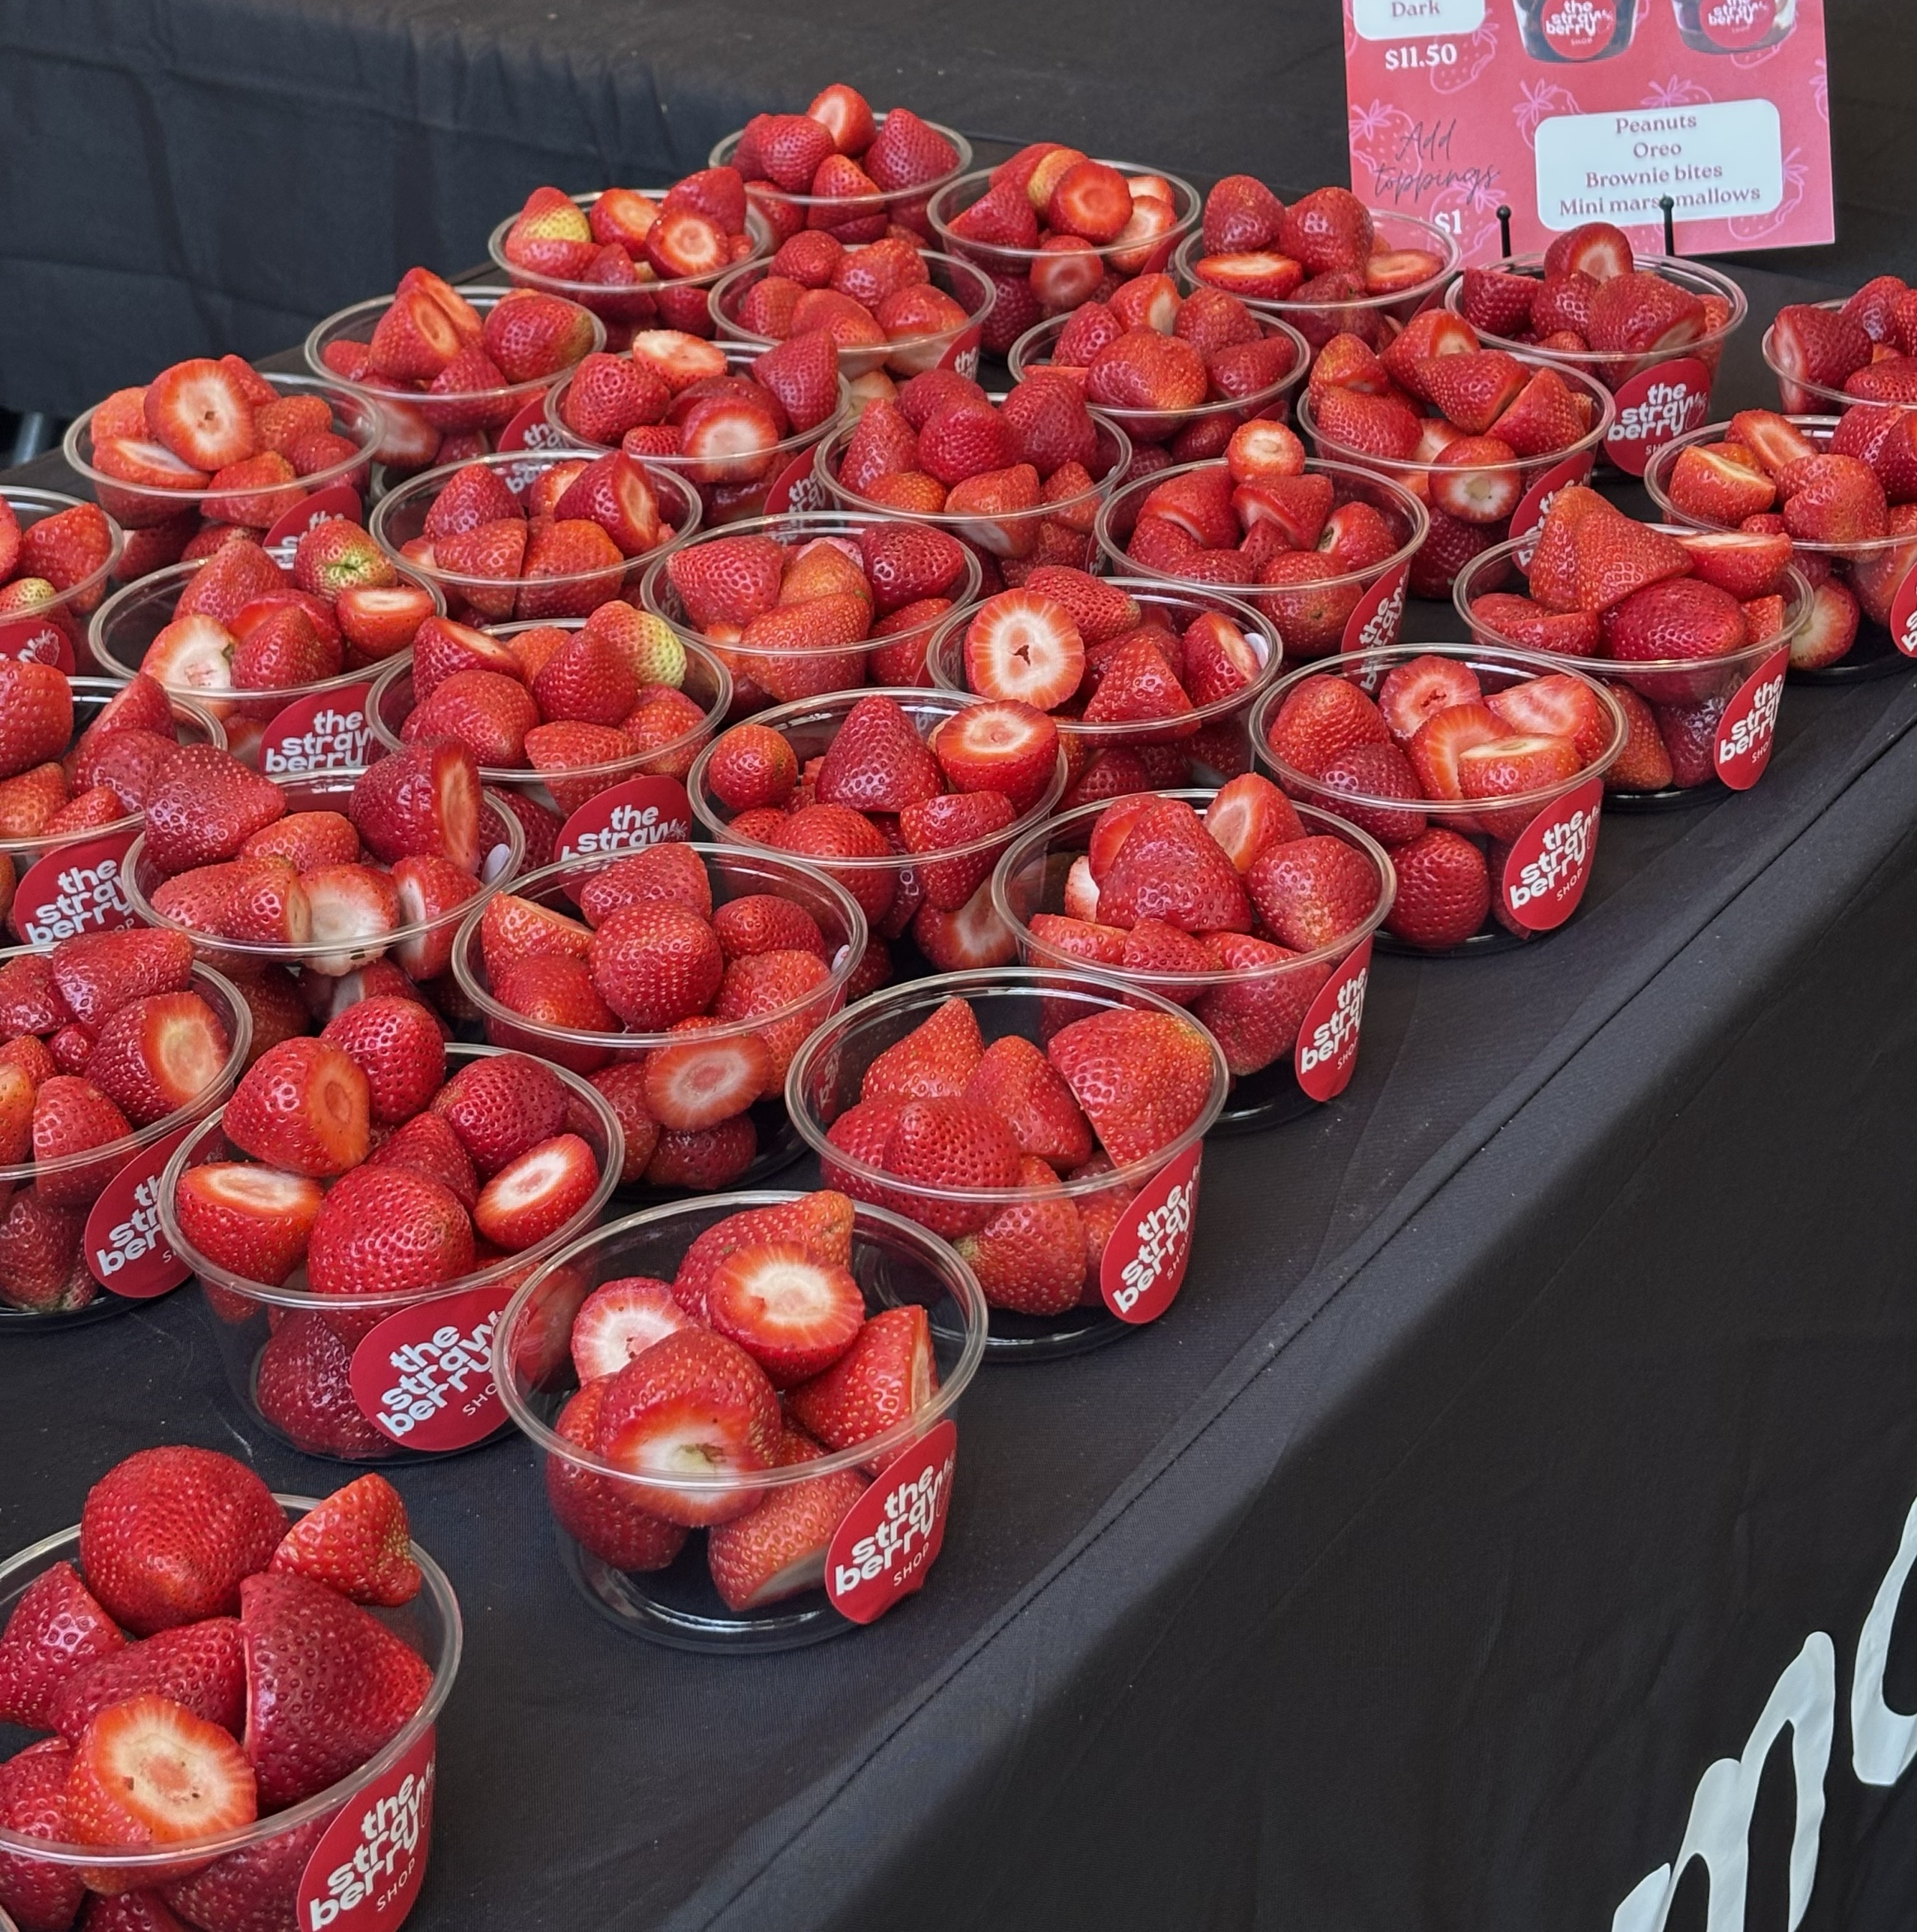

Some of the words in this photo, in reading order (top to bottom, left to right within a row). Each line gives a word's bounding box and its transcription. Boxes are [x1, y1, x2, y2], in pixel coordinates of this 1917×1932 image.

[1392, 2, 1440, 17] Dark
[1385, 44, 1457, 70] $11.50
[1396, 118, 1456, 161] Add
[1616, 115, 1697, 134] Peanuts
[1633, 142, 1682, 158] Oreo
[1372, 163, 1501, 205] toppings
[1586, 166, 1670, 188] Brownie
[1675, 164, 1723, 181] bites
[1434, 208, 1462, 234] $1
[1560, 197, 1604, 216] Mini
[1610, 187, 1761, 213] marsmallows
[1647, 383, 1687, 405] the
[1607, 415, 1684, 441] berry
[1359, 597, 1389, 644] the
[1754, 674, 1782, 709] the
[314, 709, 364, 734] the
[610, 804, 658, 831] the
[1543, 810, 1583, 850] the
[58, 860, 117, 894] the
[1510, 839, 1586, 910] berry
[1556, 868, 1582, 902] SHOP
[1337, 968, 1366, 1010] the
[109, 1205, 161, 1247] str
[1137, 1185, 1182, 1241] the
[96, 1223, 162, 1276] ber
[1112, 1204, 1190, 1313] berry
[389, 1326, 460, 1372] the
[462, 1382, 498, 1416] SHO
[884, 1465, 934, 1519] the
[835, 1503, 934, 1596] berry
[893, 1542, 929, 1587] SHOP
[362, 1774, 414, 1840] the
[310, 1811, 418, 1932] berry
[377, 1858, 415, 1911] SHOP
